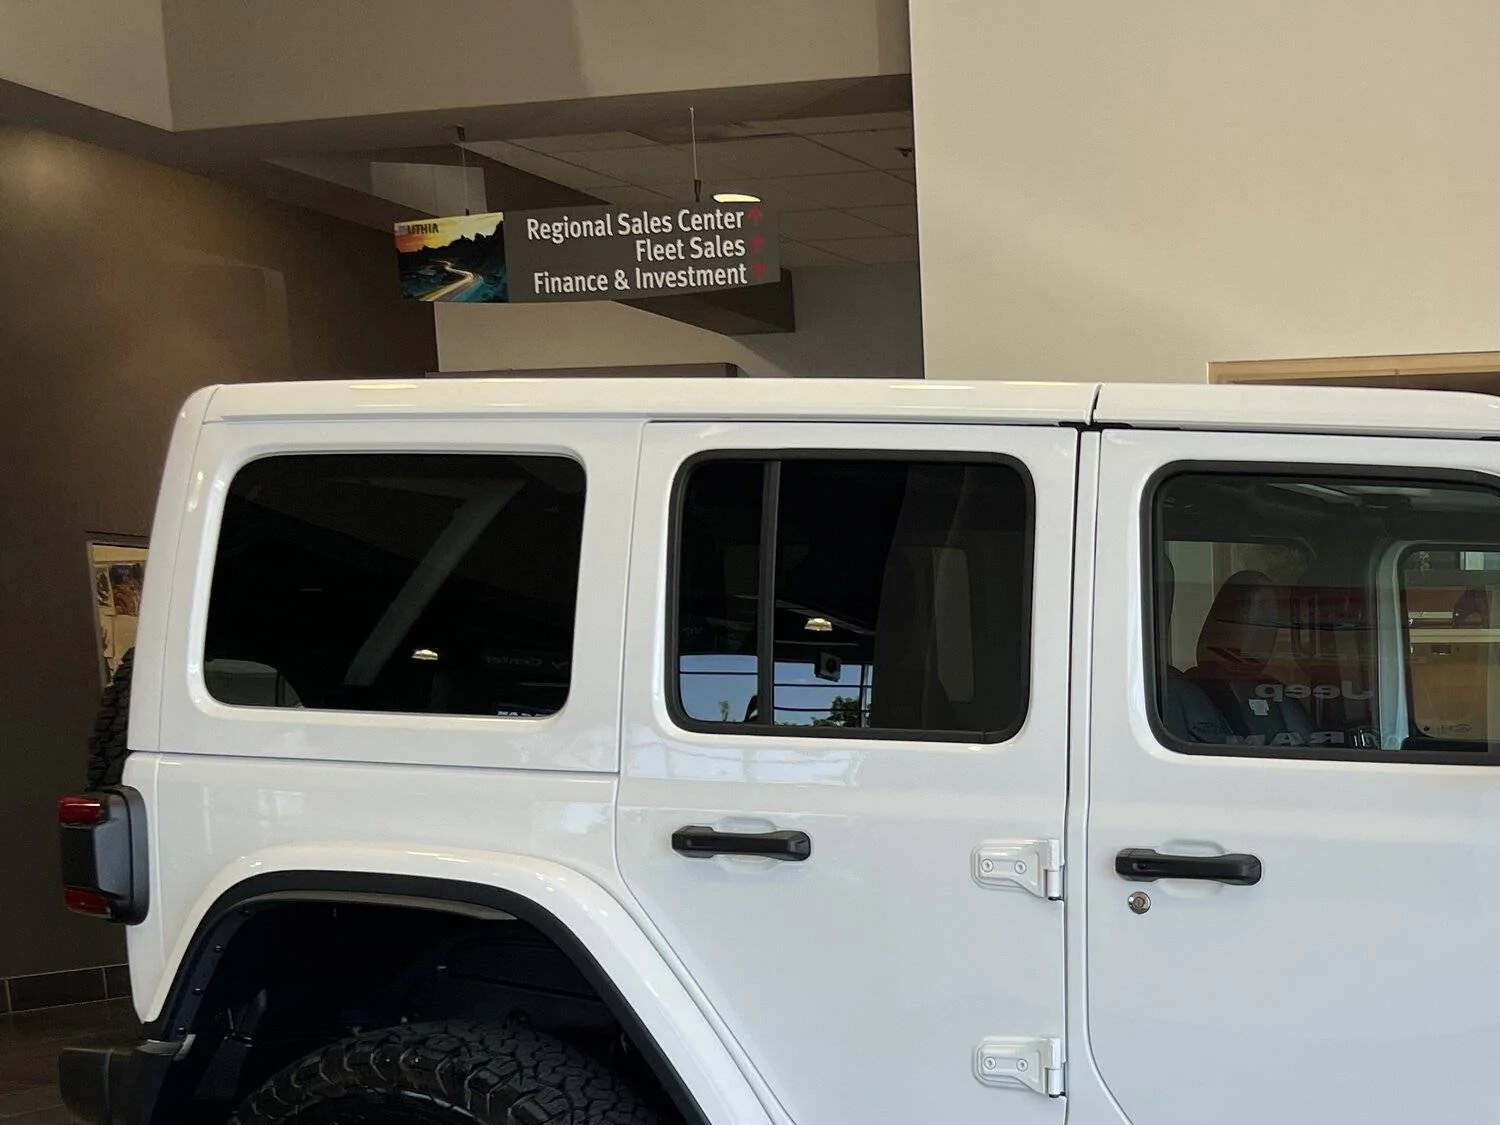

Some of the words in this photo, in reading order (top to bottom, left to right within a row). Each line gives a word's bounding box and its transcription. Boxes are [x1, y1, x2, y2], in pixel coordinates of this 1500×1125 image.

[526, 213, 613, 244] Regional
[617, 211, 673, 236] Sales
[677, 209, 744, 232] Center
[635, 239, 685, 262] Fleet
[689, 235, 746, 259] Sales
[534, 271, 609, 294] Finance
[614, 269, 631, 291] &
[635, 263, 748, 289] Investment
